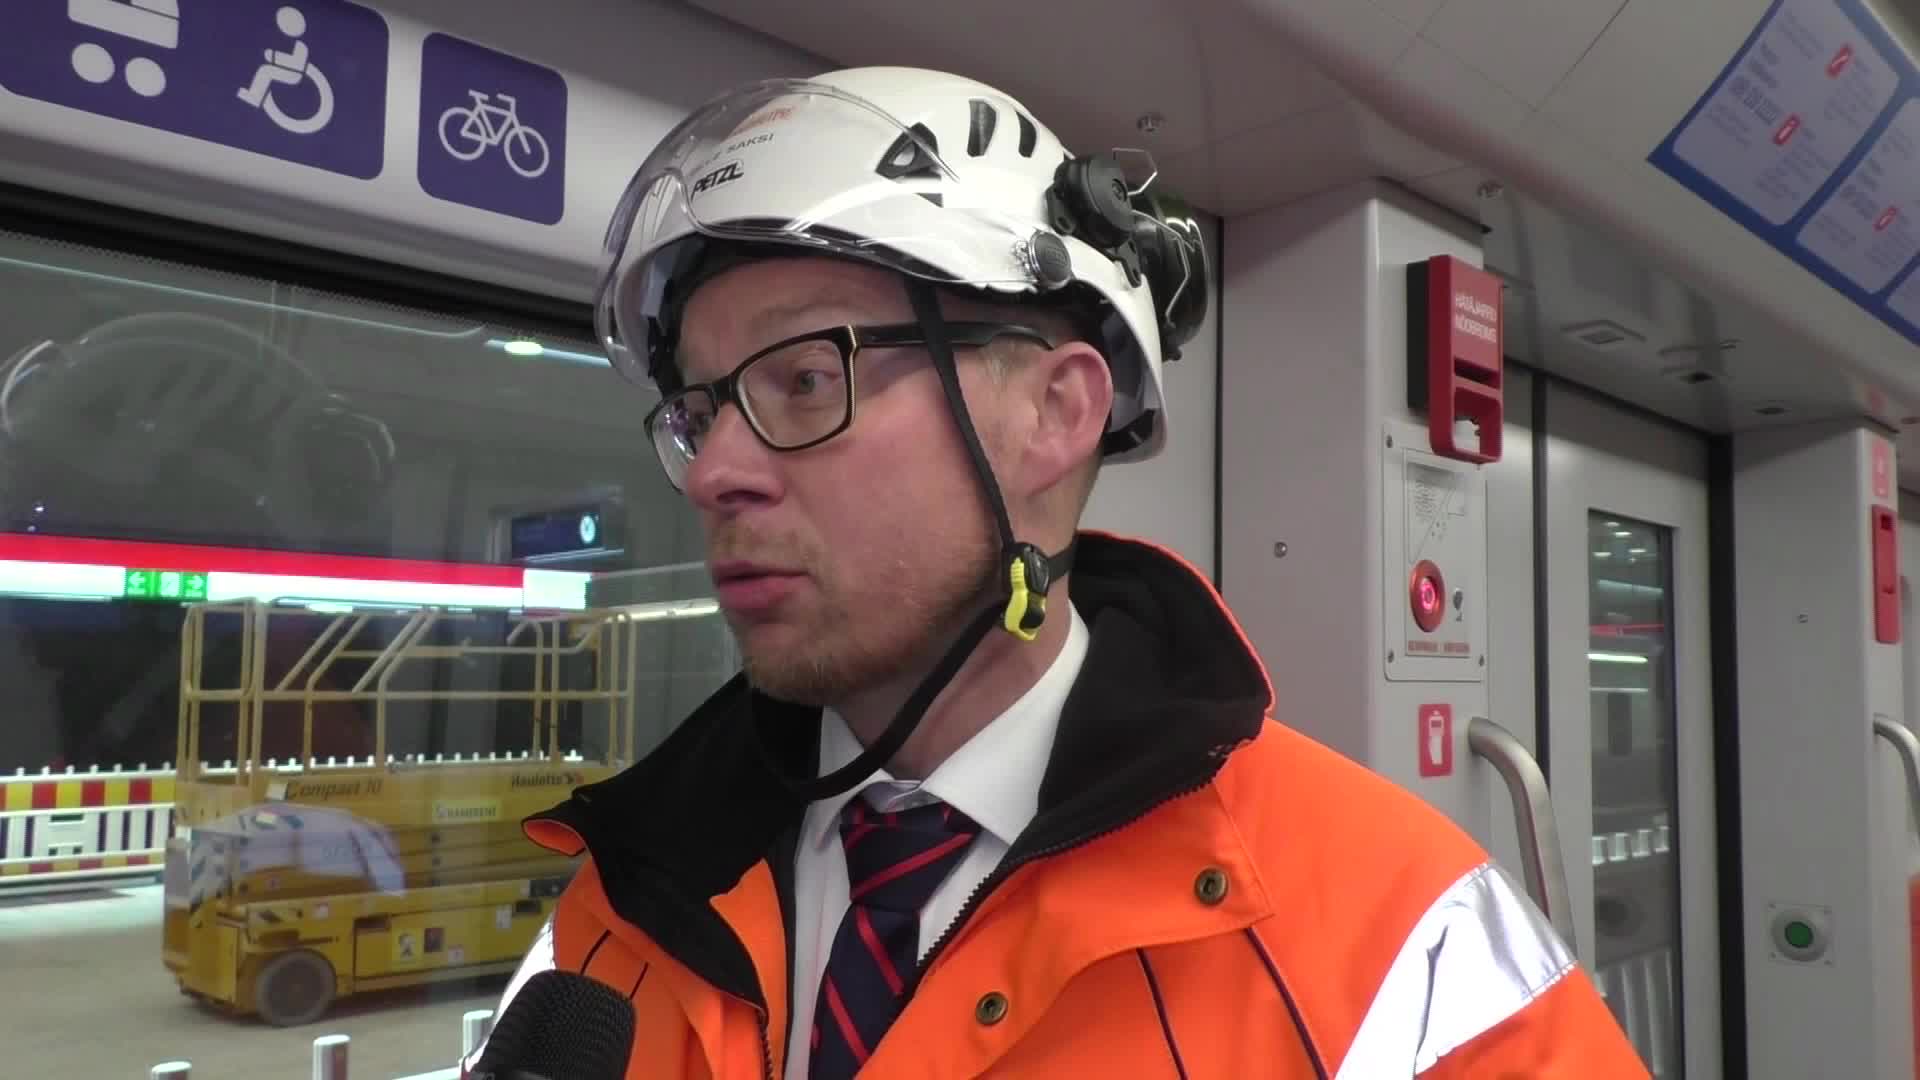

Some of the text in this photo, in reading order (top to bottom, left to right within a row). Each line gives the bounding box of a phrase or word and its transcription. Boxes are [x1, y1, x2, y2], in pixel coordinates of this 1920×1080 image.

[727, 132, 775, 153] SAKSI
[690, 161, 745, 202] PETZL
[286, 778, 362, 801] Compact
